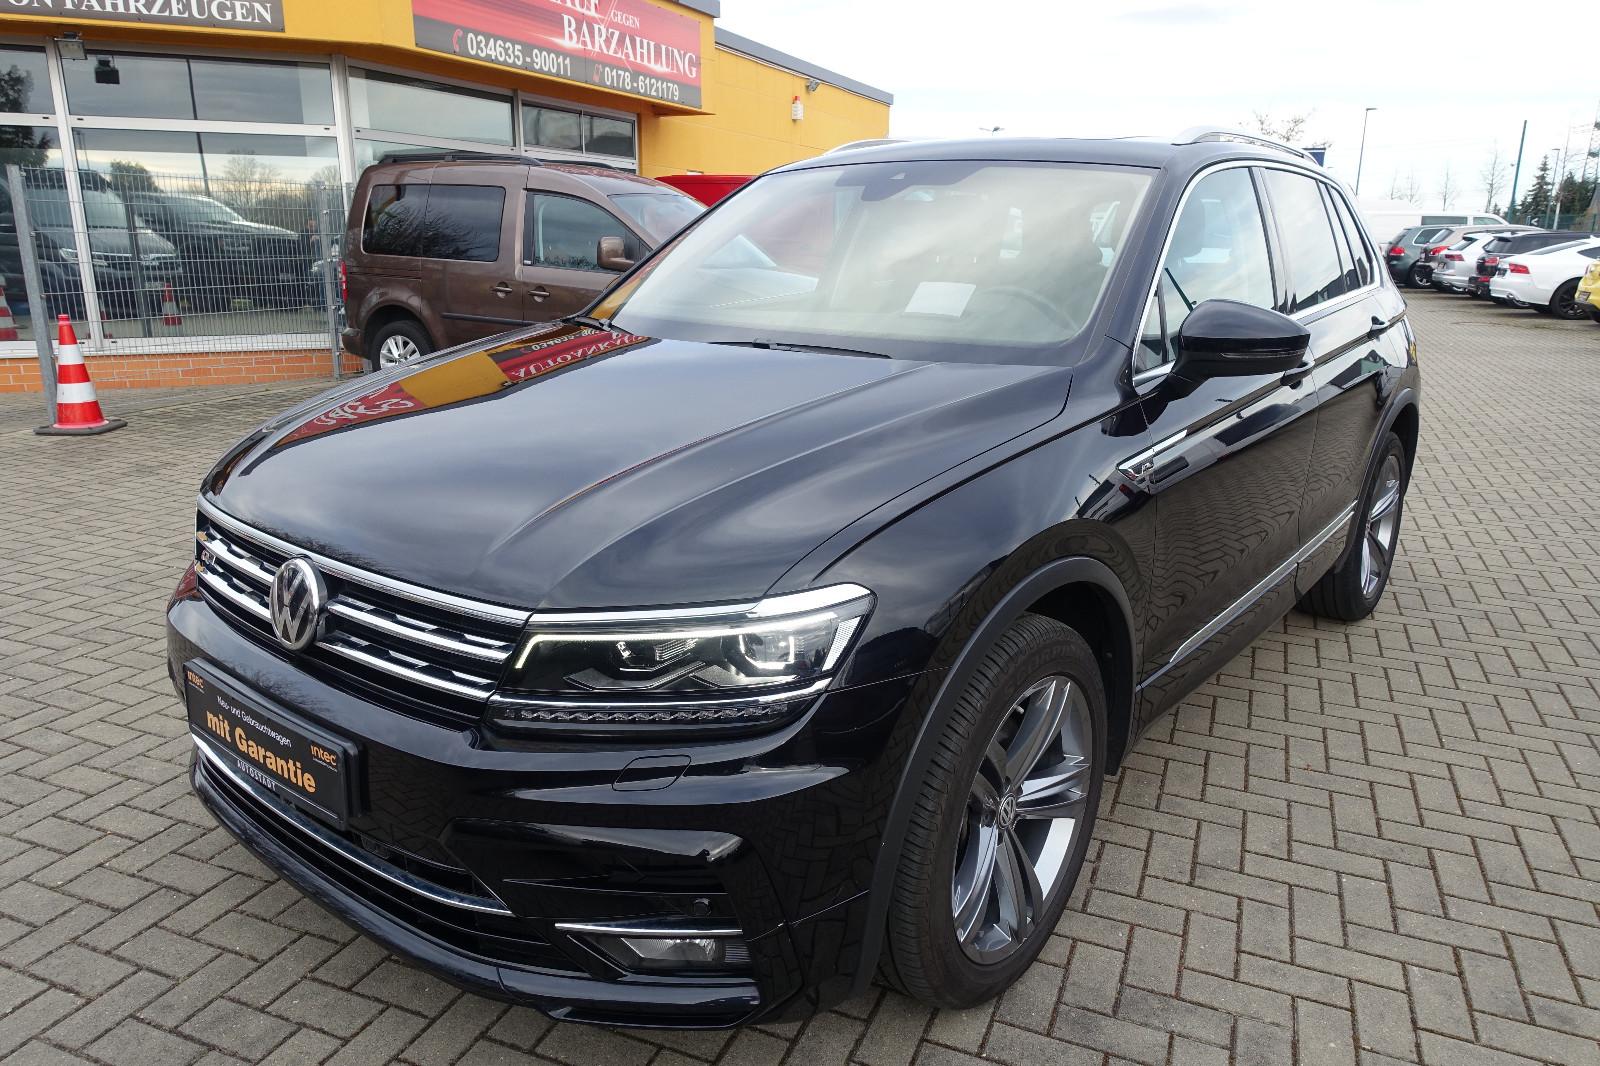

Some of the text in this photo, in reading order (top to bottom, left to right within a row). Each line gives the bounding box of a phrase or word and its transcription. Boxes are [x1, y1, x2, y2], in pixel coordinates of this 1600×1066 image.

[610, 9, 640, 29] GEGEN
[561, 13, 697, 78] BARZAHLUNG
[230, 705, 241, 718] und
[241, 710, 292, 748] Gebrauchtwagen
[206, 710, 316, 793] mit Garantie
[310, 744, 338, 766] intec
[237, 759, 277, 792] AUTOSTADT
